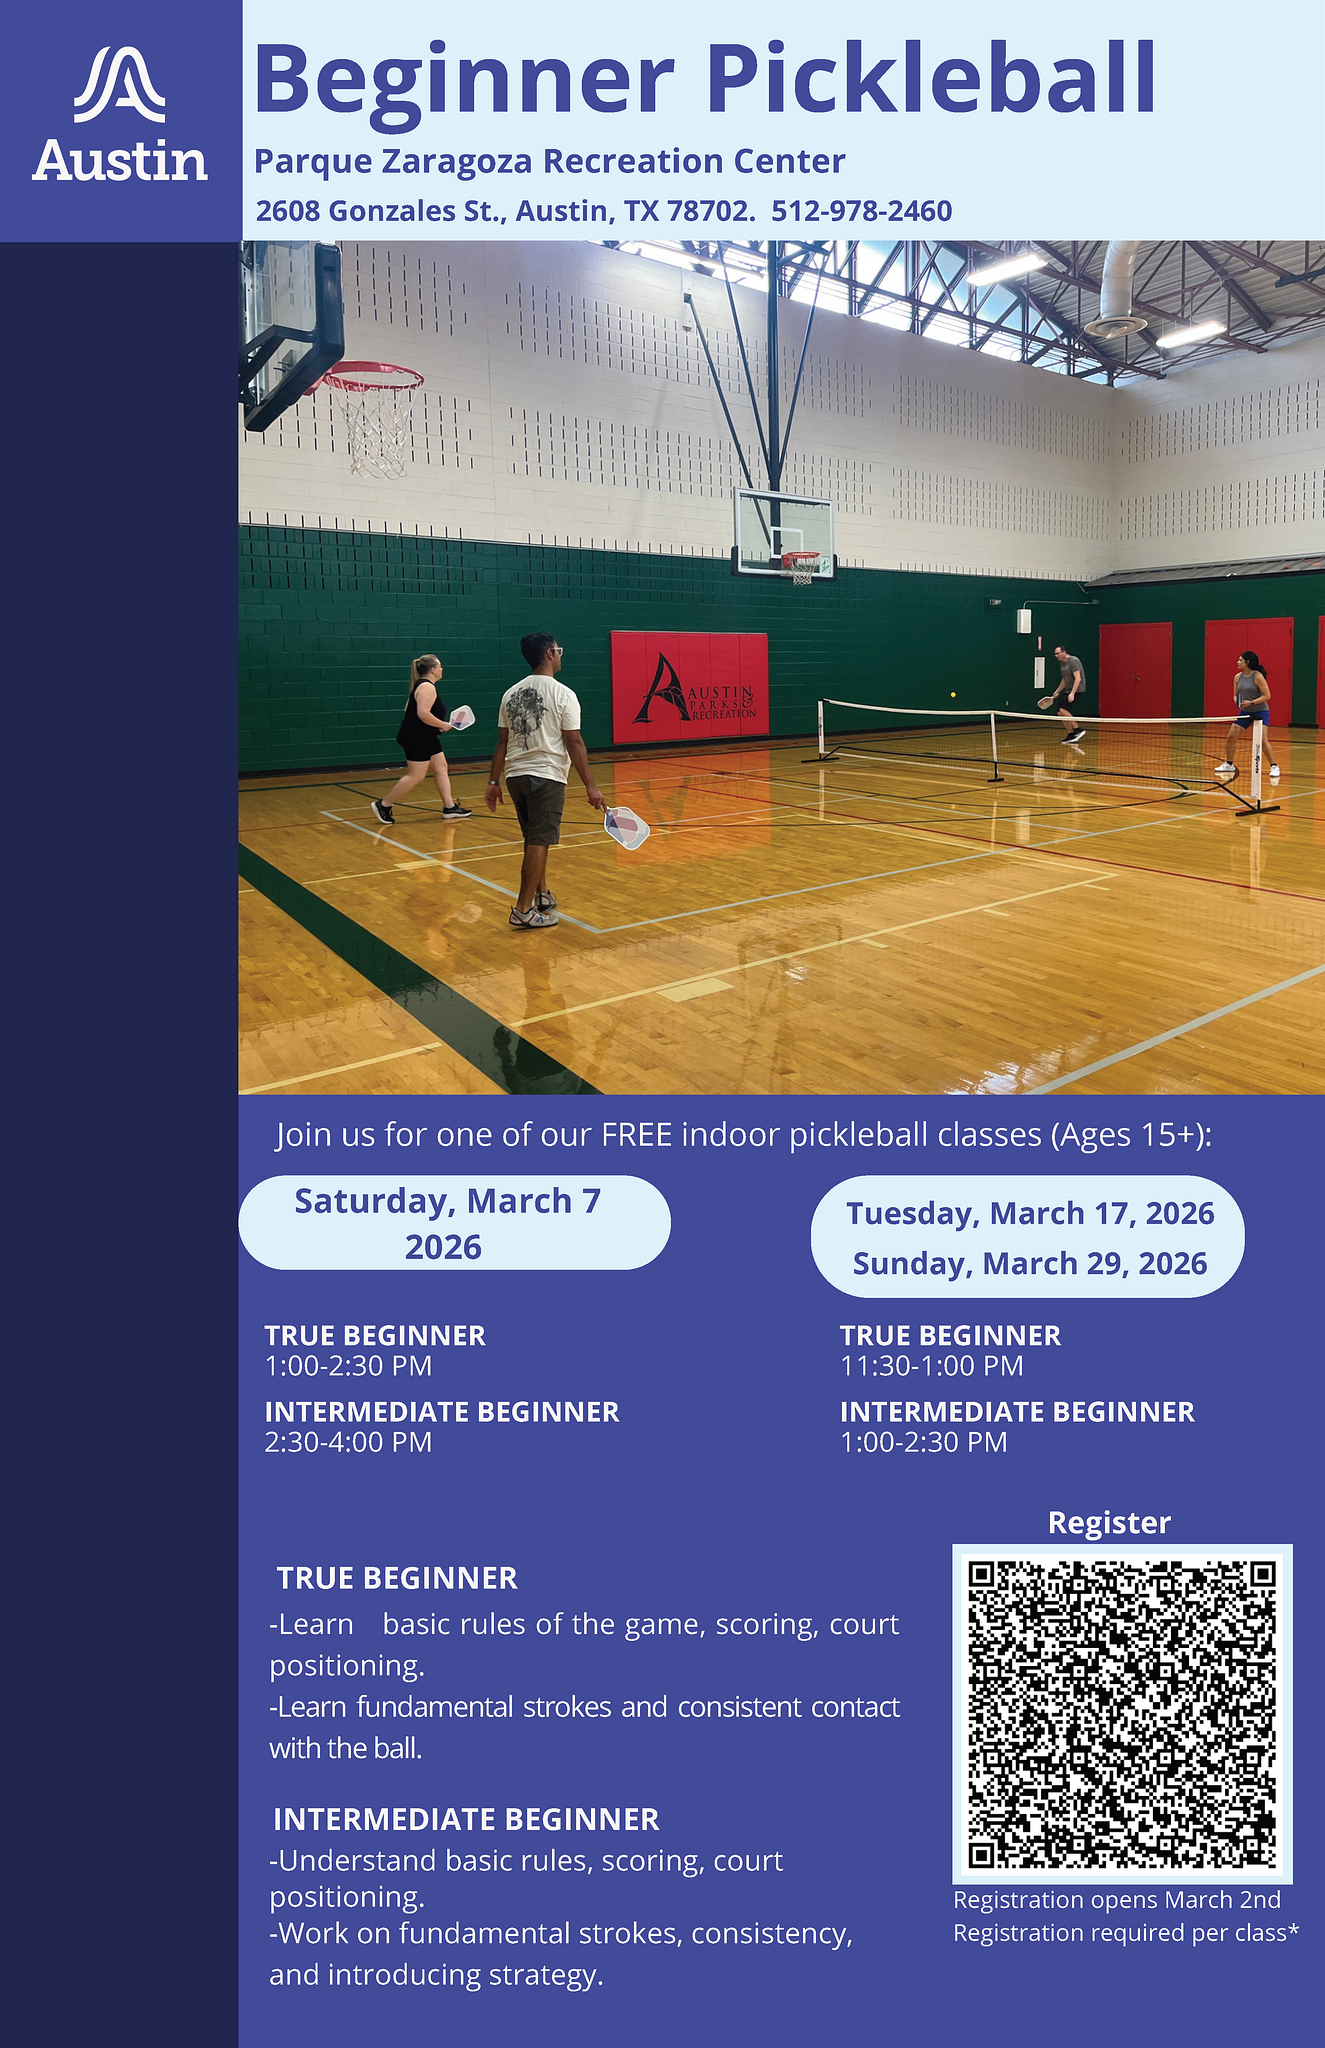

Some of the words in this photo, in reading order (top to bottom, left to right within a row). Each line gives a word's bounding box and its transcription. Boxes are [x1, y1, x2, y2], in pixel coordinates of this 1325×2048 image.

[257, 40, 675, 135] Beginner
[710, 40, 1153, 113] Pickleball
[32, 139, 208, 181] Austin
[256, 149, 372, 181] Parque
[382, 149, 531, 181] Zaragoza
[545, 147, 722, 173] Recreation
[735, 148, 846, 173] Center
[257, 200, 320, 221] 2608
[329, 199, 455, 221] Gonzales
[465, 200, 506, 225] St.,
[516, 199, 615, 225] Austin,
[624, 200, 659, 221] TX
[667, 200, 755, 221] 78702.
[772, 200, 952, 221] 512-978-2460
[688, 686, 752, 700] AUSTIN
[690, 700, 738, 710] PARKS
[742, 694, 753, 708] &
[693, 709, 757, 720] RECREATION
[274, 1122, 330, 1152] Join
[343, 1128, 374, 1146] us
[384, 1121, 427, 1146] for
[437, 1128, 492, 1146] one
[503, 1121, 533, 1146] of
[542, 1128, 592, 1146] our
[604, 1123, 671, 1146] FREE
[683, 1121, 780, 1146] indoor
[791, 1121, 926, 1154] pickleball
[939, 1121, 1041, 1146] classes
[1052, 1123, 1130, 1154] (Ages
[1143, 1123, 1210, 1151] 15+):
[296, 1187, 455, 1221] Saturday,
[469, 1187, 571, 1213] March
[583, 1188, 600, 1213] 7
[847, 1200, 979, 1231] Tuesday,
[992, 1200, 1084, 1225] March
[1096, 1202, 1136, 1228] 17,
[1147, 1202, 1214, 1225] 2026
[406, 1234, 481, 1260] 2026
[854, 1251, 972, 1282] Sunday,
[984, 1251, 1077, 1275] March
[1088, 1252, 1128, 1278] 29,
[1139, 1252, 1207, 1275] 2026
[264, 1325, 334, 1346] TRUE
[345, 1325, 486, 1346] BEGINNER
[840, 1325, 910, 1346] TRUE
[920, 1325, 1061, 1346] BEGINNER
[267, 1355, 382, 1376] 1:00-2:30
[394, 1355, 431, 1376] PM
[842, 1355, 974, 1376] 11:30-1:00
[985, 1355, 1022, 1376] PM
[266, 1402, 468, 1422] INTERMEDIATE
[479, 1401, 620, 1422] BEGINNER
[842, 1402, 1043, 1422] INTERMEDIATE
[1054, 1401, 1195, 1422] BEGINNER
[265, 1431, 382, 1452] 2:30-4:00
[394, 1432, 431, 1452] PM
[842, 1431, 958, 1452] 1:00-2:30
[969, 1432, 1006, 1452] PM
[1050, 1510, 1171, 1541] Register
[277, 1567, 353, 1589] TRUE
[365, 1567, 518, 1589] BEGINNER
[270, 1613, 352, 1635] -Learn
[384, 1612, 450, 1635] basic
[462, 1612, 525, 1635] rules
[537, 1612, 564, 1635] of
[572, 1612, 614, 1635] the
[625, 1618, 705, 1641] game,
[717, 1613, 818, 1641] scoring,
[831, 1615, 899, 1635] court
[271, 1654, 424, 1682] positioning.
[270, 1696, 345, 1717] -Learn
[356, 1695, 512, 1717] fundamental
[524, 1695, 611, 1717] strokes
[622, 1695, 666, 1717] and
[679, 1696, 802, 1717] consistent
[812, 1698, 900, 1717] contact
[269, 1736, 320, 1759] with
[327, 1736, 367, 1759] the
[375, 1736, 421, 1759] ball.
[275, 1808, 494, 1830] INTERMEDIATE
[506, 1808, 660, 1831] BEGINNER
[270, 1849, 435, 1871] -Understand
[447, 1849, 512, 1871] basic
[523, 1849, 592, 1874] rules,
[603, 1849, 704, 1878] scoring,
[714, 1851, 783, 1871] court
[271, 1886, 424, 1914] positioning.
[955, 1891, 1083, 1914] Registration
[1092, 1895, 1157, 1914] opens
[1166, 1890, 1232, 1908] March
[1241, 1890, 1280, 1908] 2nd
[270, 1921, 348, 1944] -Work
[358, 1927, 389, 1944] on
[399, 1921, 569, 1944] fundamental
[580, 1921, 682, 1947] strokes,
[692, 1922, 852, 1950] consistency,
[955, 1923, 1083, 1947] Registration
[1092, 1923, 1184, 1947] required
[1193, 1928, 1228, 1947] per
[270, 1963, 318, 1985] and
[330, 1963, 481, 1992] introducing
[490, 1965, 602, 1992] strategy.
